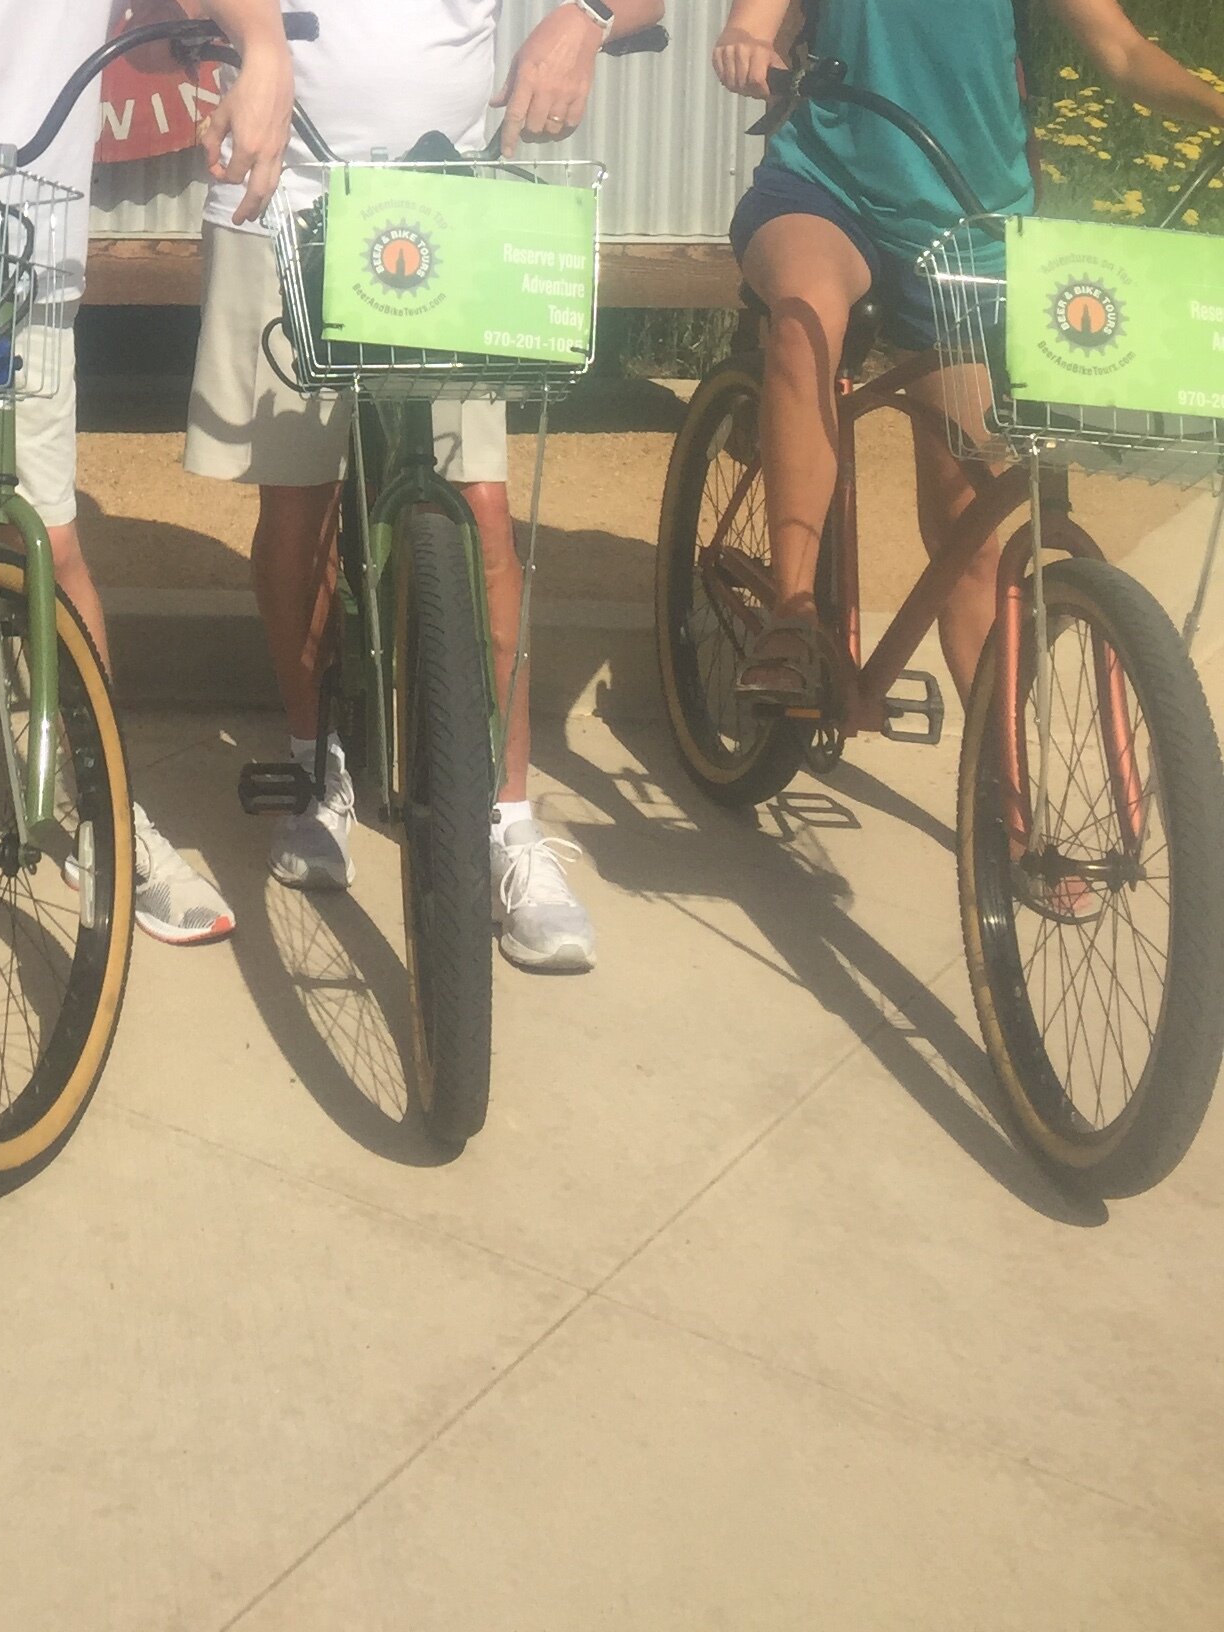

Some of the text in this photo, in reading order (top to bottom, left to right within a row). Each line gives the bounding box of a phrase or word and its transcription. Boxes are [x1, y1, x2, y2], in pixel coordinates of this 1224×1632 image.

[373, 229, 430, 278] BEER & BIKE TOURS
[503, 243, 586, 272] Reserve your
[521, 273, 585, 298] Adventure
[548, 305, 585, 331] Today
[1057, 286, 1116, 335] BEER & BIKE TOURS
